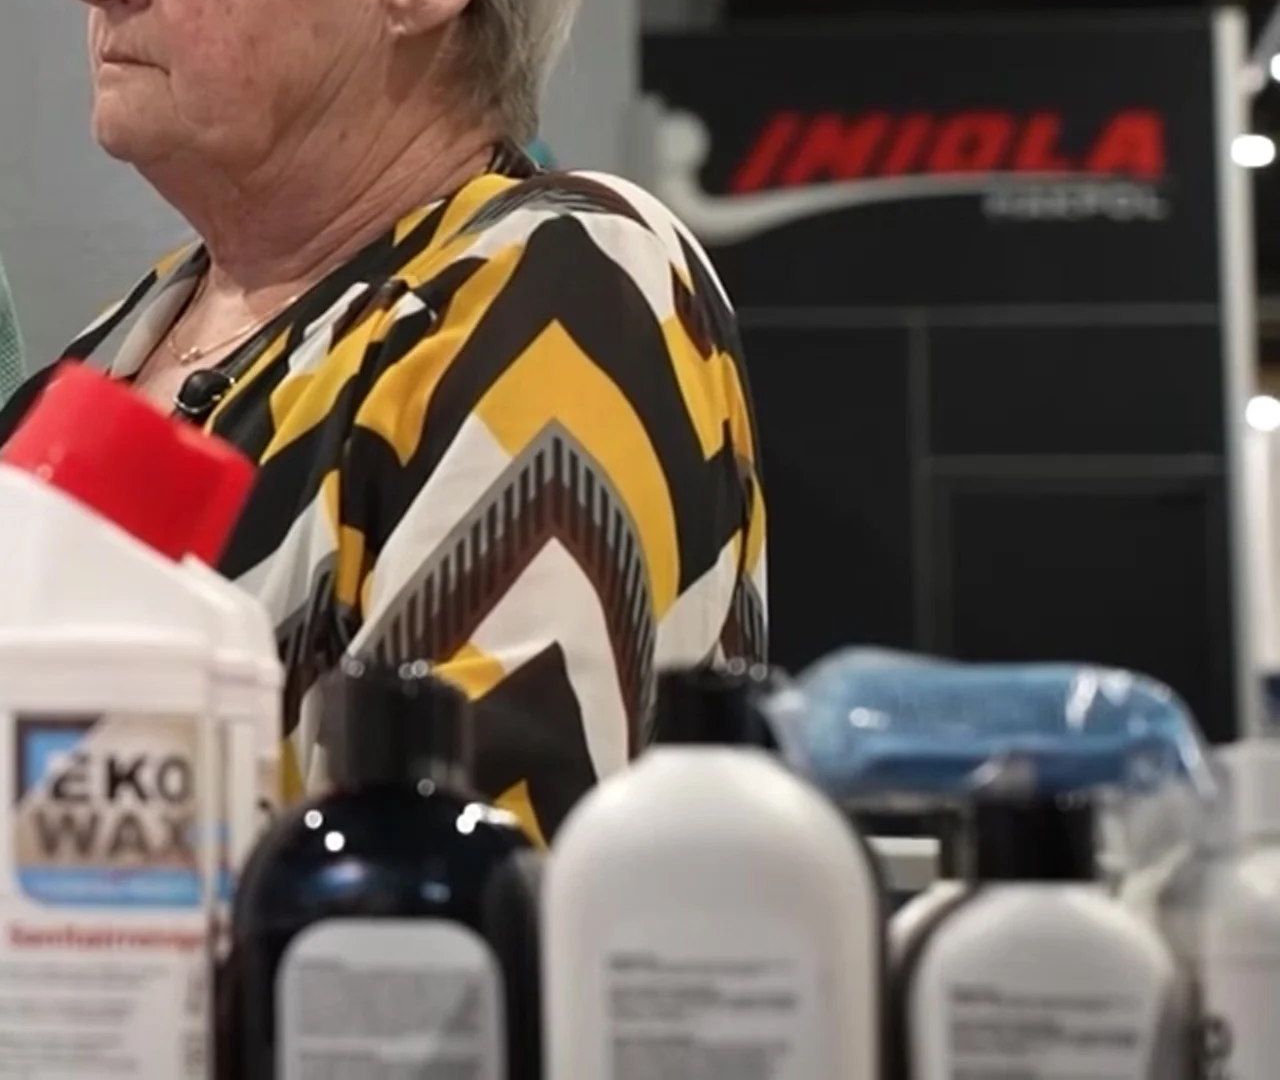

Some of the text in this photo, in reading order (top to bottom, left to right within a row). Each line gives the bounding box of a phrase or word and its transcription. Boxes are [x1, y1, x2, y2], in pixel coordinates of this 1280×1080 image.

[732, 108, 1167, 196] IMIOLA
[48, 752, 196, 805] EKO
[34, 811, 197, 860] WAX
